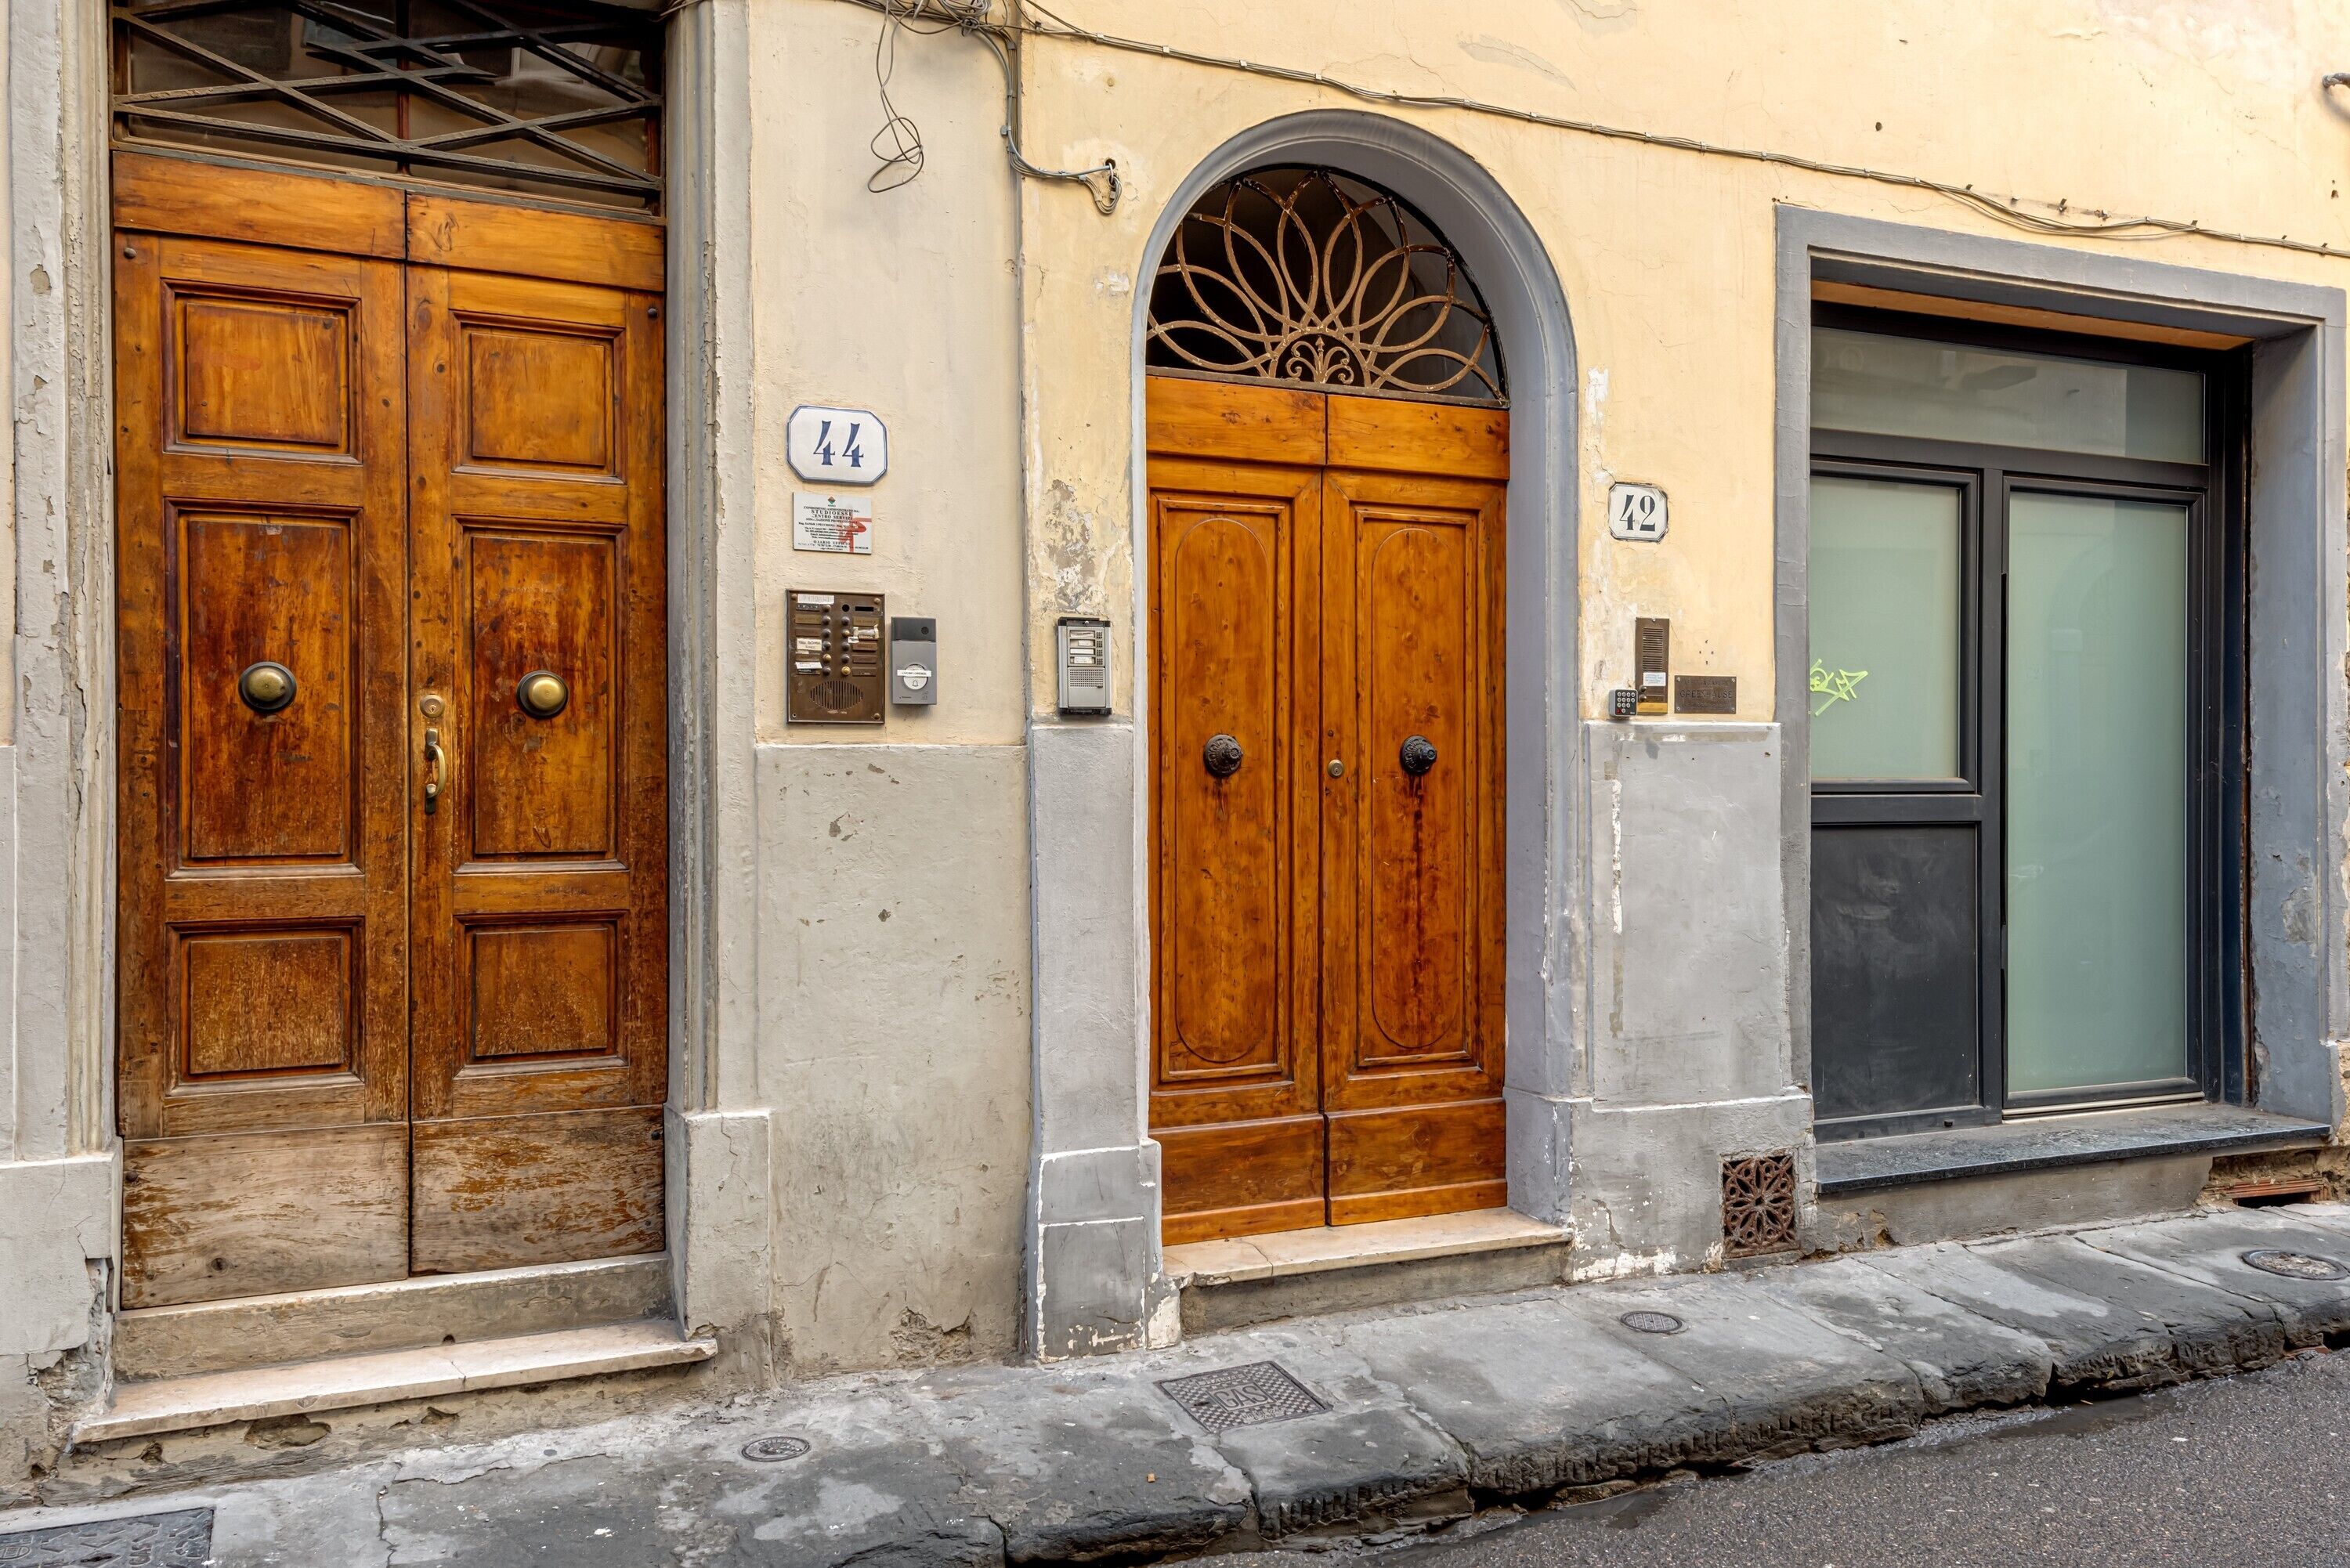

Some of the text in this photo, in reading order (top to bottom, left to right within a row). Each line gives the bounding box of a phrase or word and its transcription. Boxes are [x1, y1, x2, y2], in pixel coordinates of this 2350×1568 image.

[813, 420, 864, 468] 44
[1619, 494, 1656, 532] 42
[1213, 1386, 1268, 1408] GAS
